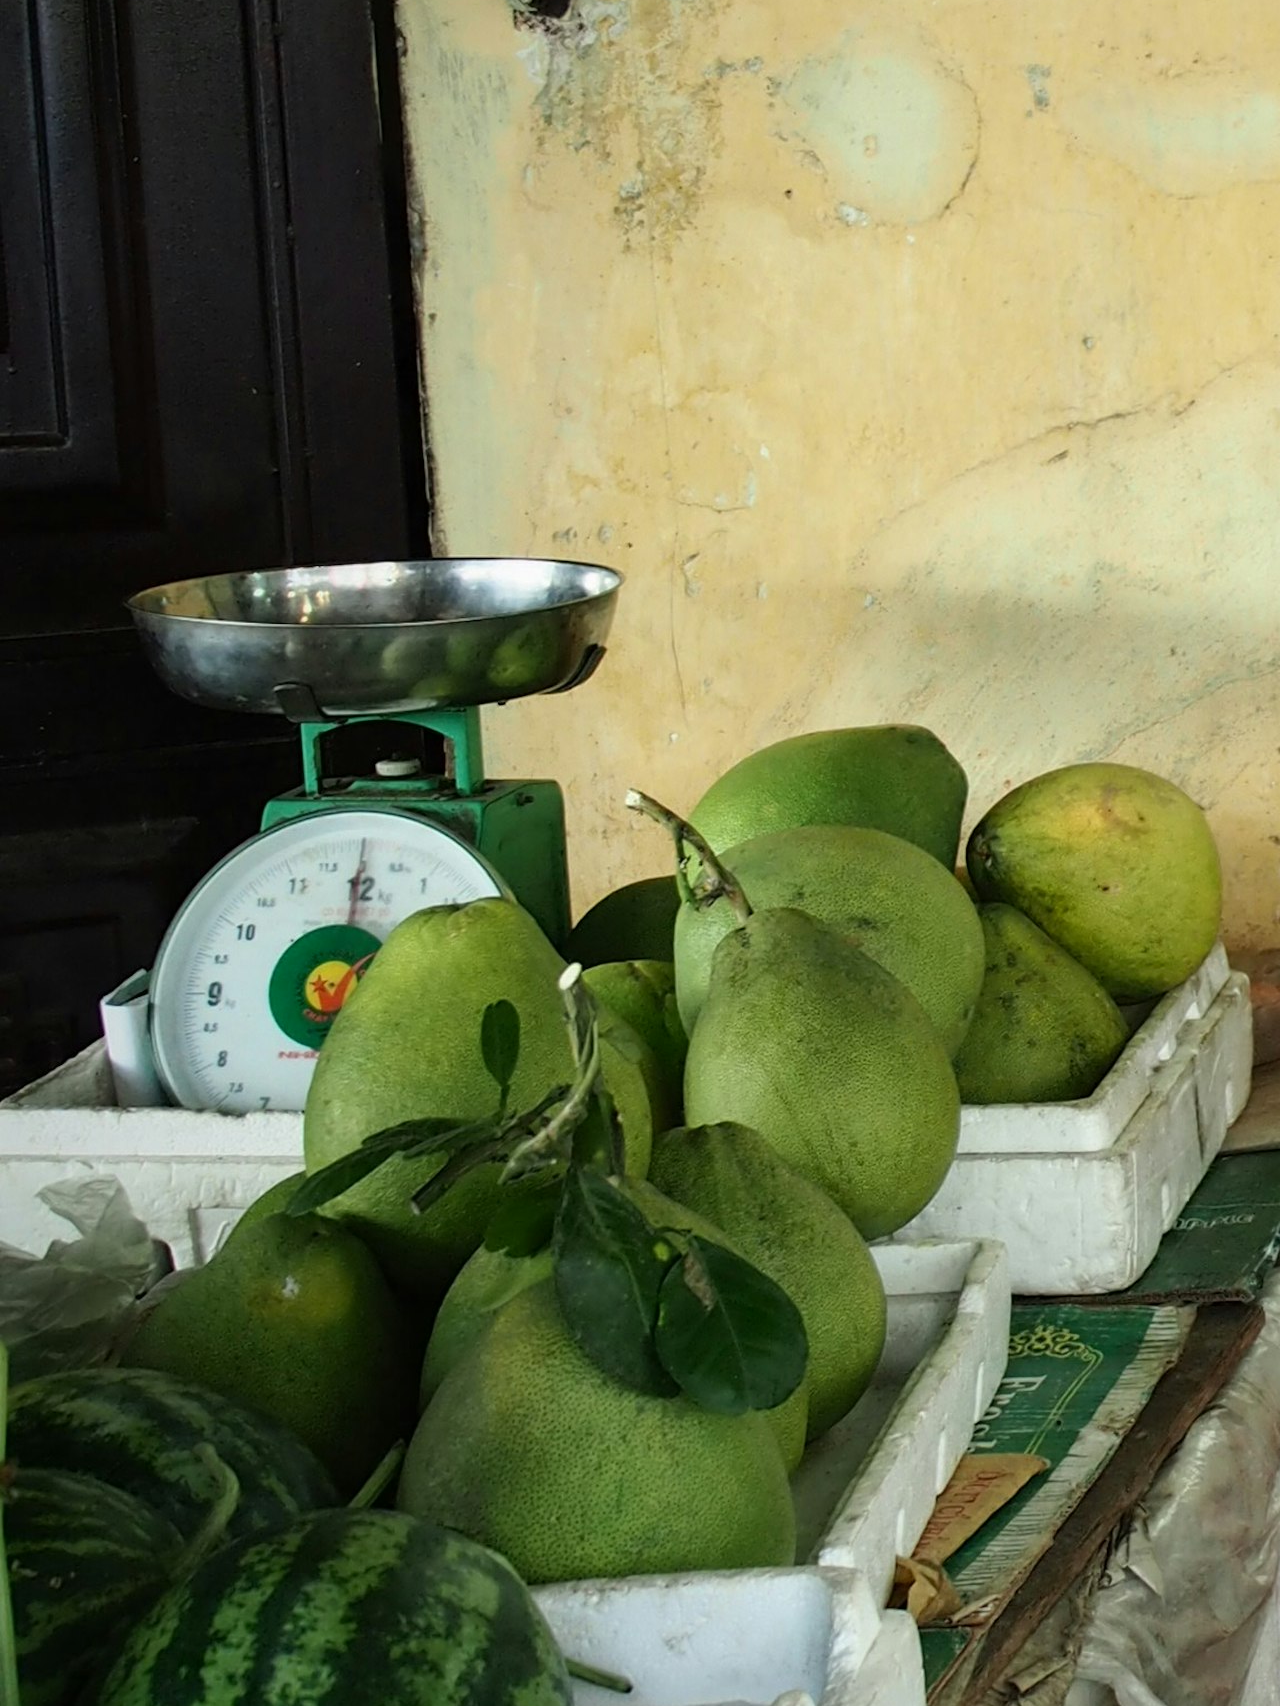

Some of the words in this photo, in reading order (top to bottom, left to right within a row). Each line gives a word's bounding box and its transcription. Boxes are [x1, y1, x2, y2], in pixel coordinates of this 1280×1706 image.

[289, 877, 308, 894] 11
[347, 876, 375, 901] 12
[419, 878, 427, 894] 1
[236, 924, 256, 941] 10
[207, 981, 222, 1006] 9
[217, 1050, 228, 1067] 8
[229, 1083, 244, 1092] 7,5
[259, 1097, 270, 1109] 7
